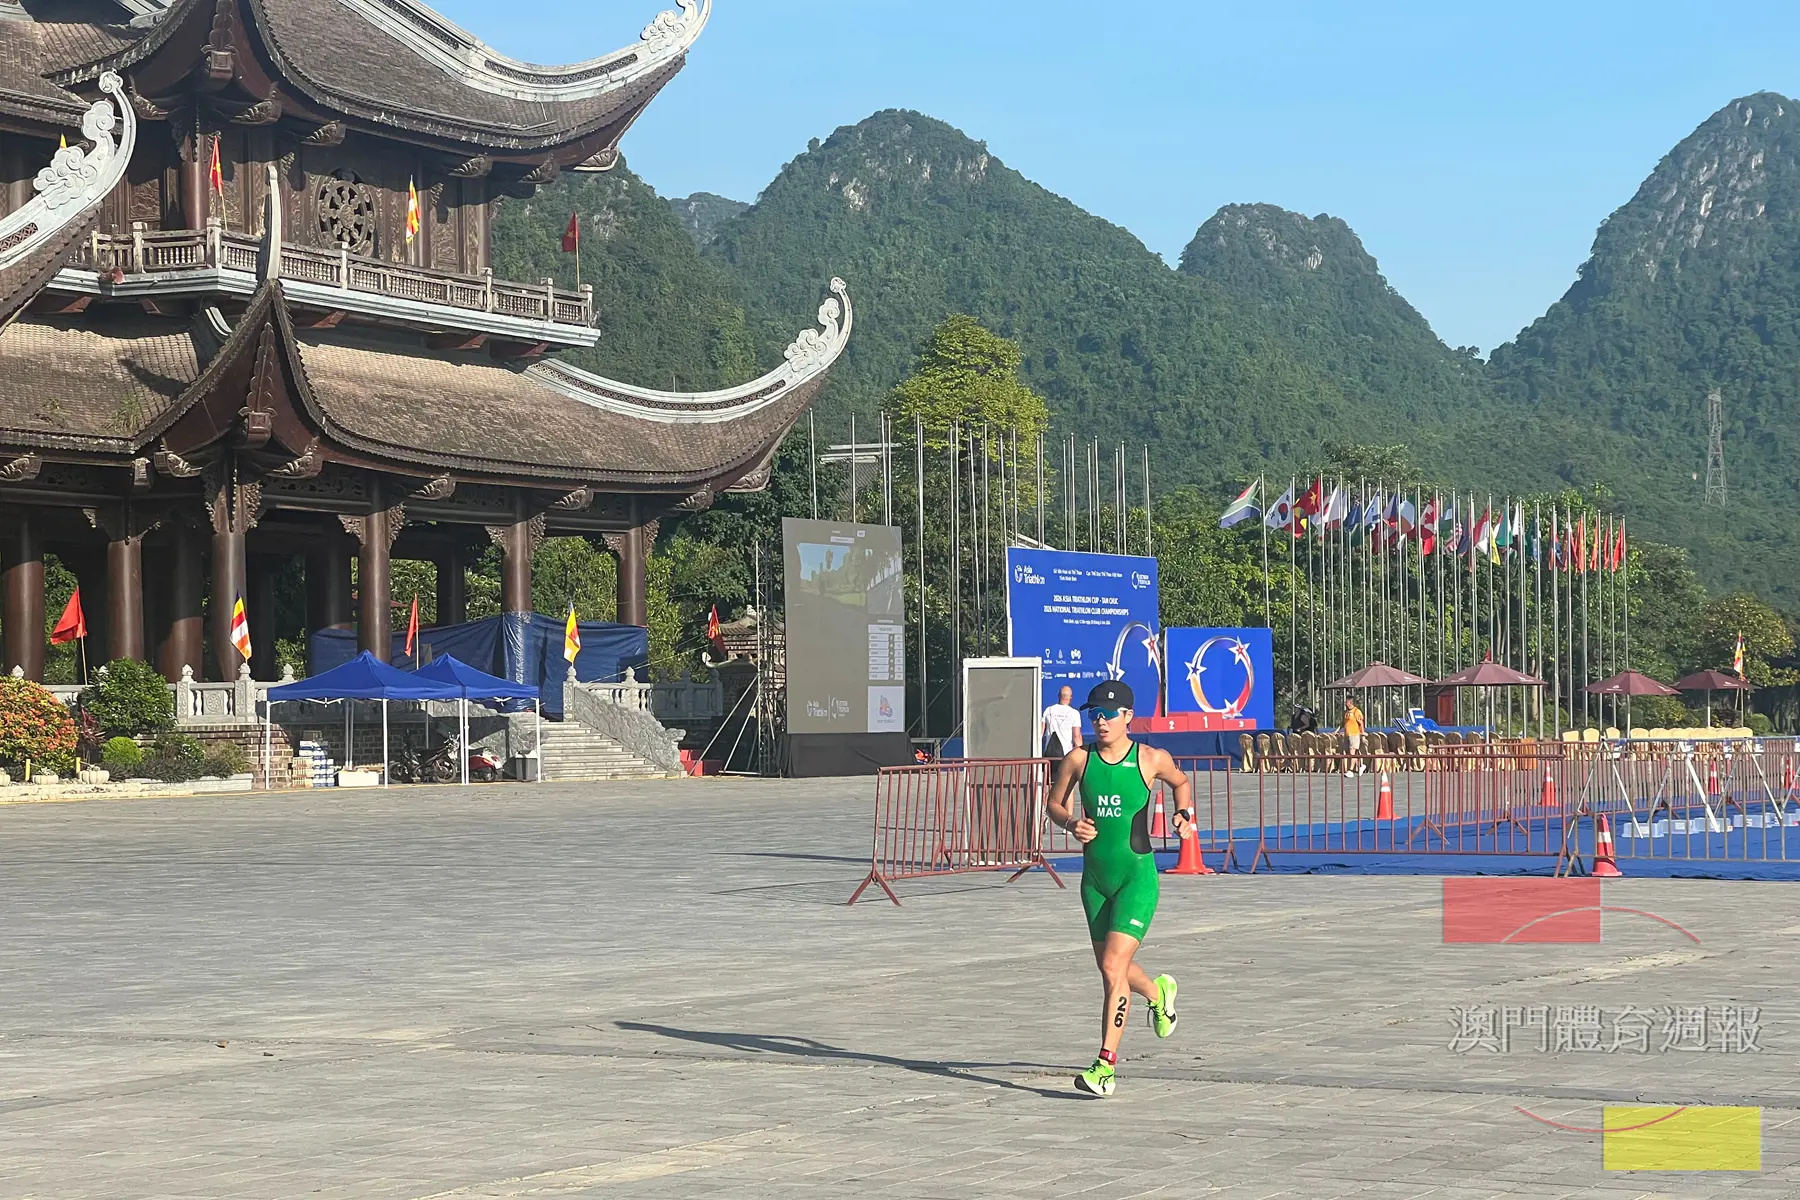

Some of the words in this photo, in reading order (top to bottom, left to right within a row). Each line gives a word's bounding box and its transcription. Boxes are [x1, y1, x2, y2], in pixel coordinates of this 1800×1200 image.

[1024, 565, 1033, 574] Asia
[1024, 574, 1046, 585] Triathlon
[1063, 595, 1072, 603] ASIA
[1072, 595, 1091, 604] TRIATHLON
[1091, 596, 1099, 604] CUP
[1052, 605, 1071, 614] NATIONAL
[1071, 606, 1091, 615] TRIATHLON
[1169, 720, 1175, 730] 2
[1203, 715, 1209, 729] 1
[1239, 720, 1245, 728] 3
[1098, 794, 1121, 806] NG
[1097, 807, 1122, 818] MAC
